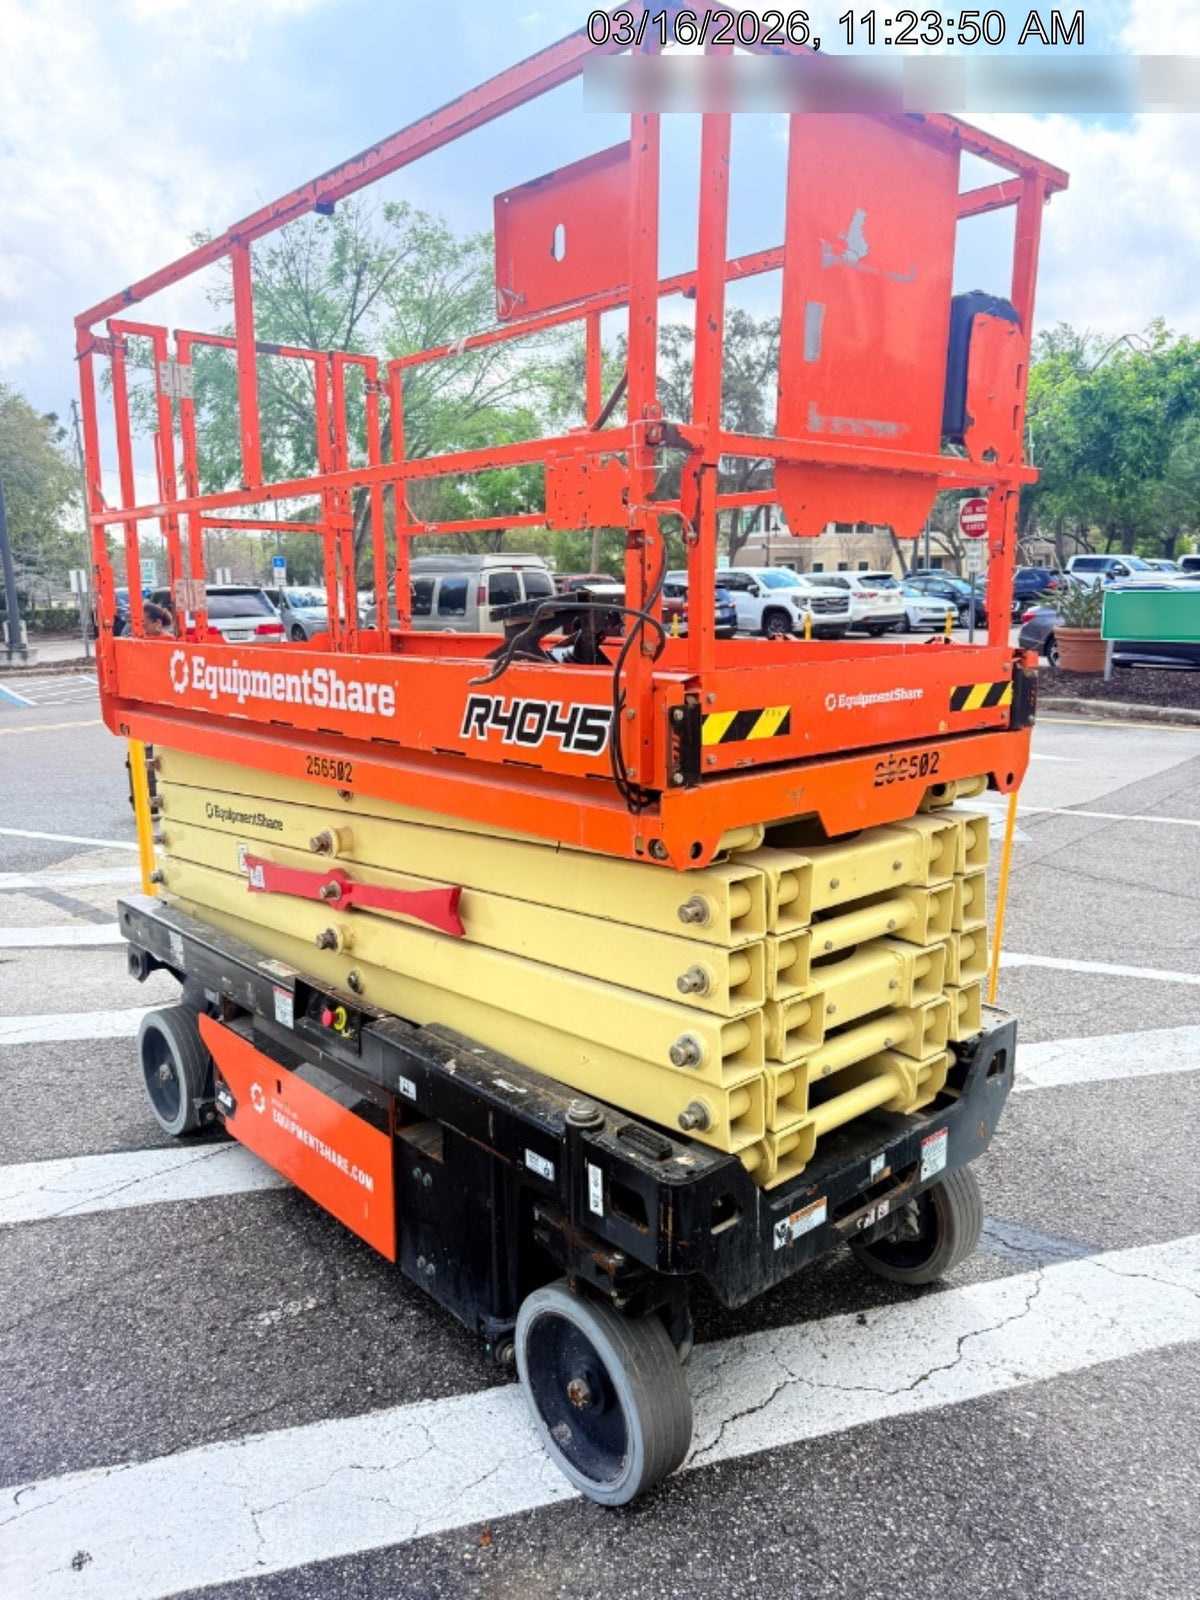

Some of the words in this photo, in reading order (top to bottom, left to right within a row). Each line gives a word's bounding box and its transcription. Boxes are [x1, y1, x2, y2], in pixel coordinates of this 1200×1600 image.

[191, 656, 395, 717] EquipmentShare
[838, 688, 923, 709] EquipmentShare
[461, 693, 614, 756] R4045
[305, 755, 353, 783] 256502
[214, 805, 284, 831] EquipmentShare
[272, 1109, 374, 1192] EQUIPMENTSHARE.COM
